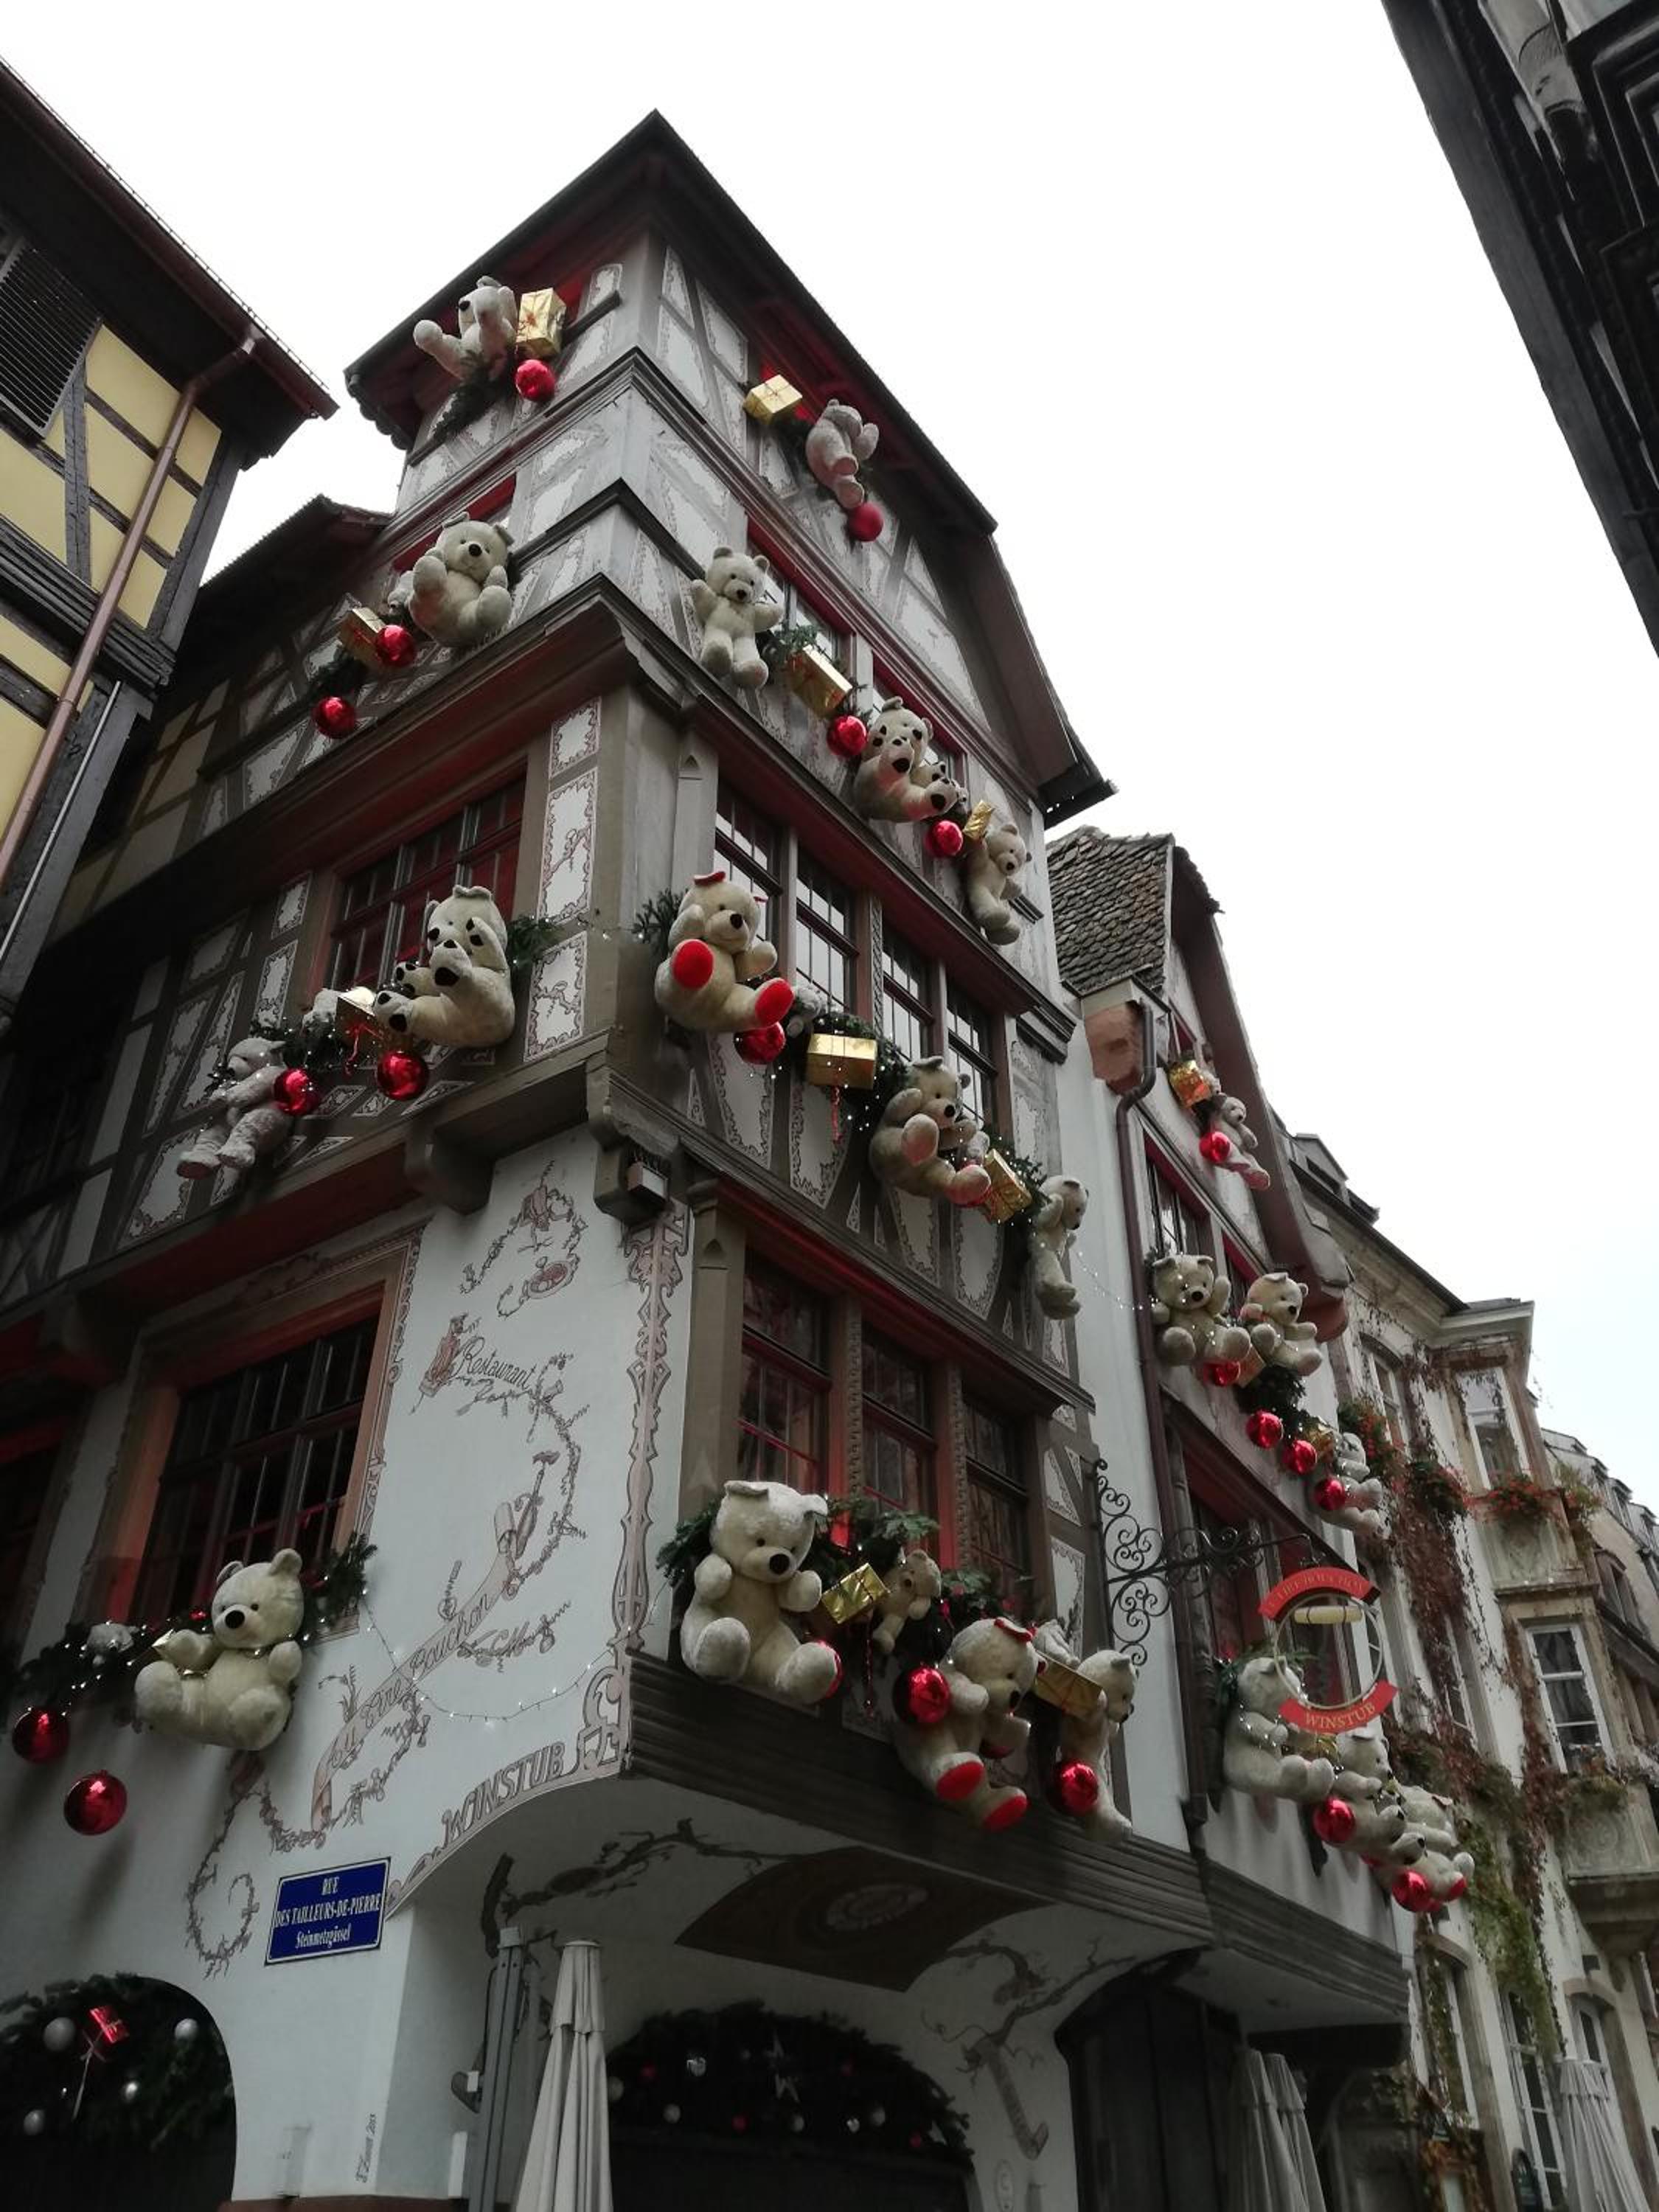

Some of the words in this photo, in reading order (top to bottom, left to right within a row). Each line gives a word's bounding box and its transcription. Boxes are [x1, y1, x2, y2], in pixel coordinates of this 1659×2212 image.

[451, 1335, 537, 1390] Restaurant
[410, 1593, 493, 1679] Bouchon
[1305, 1703, 1374, 1728] WINSTUB
[321, 1877, 339, 1896] RUE
[274, 1910, 291, 1927] DES
[291, 1893, 380, 1924] TAILLEURS-DE-PIERRE
